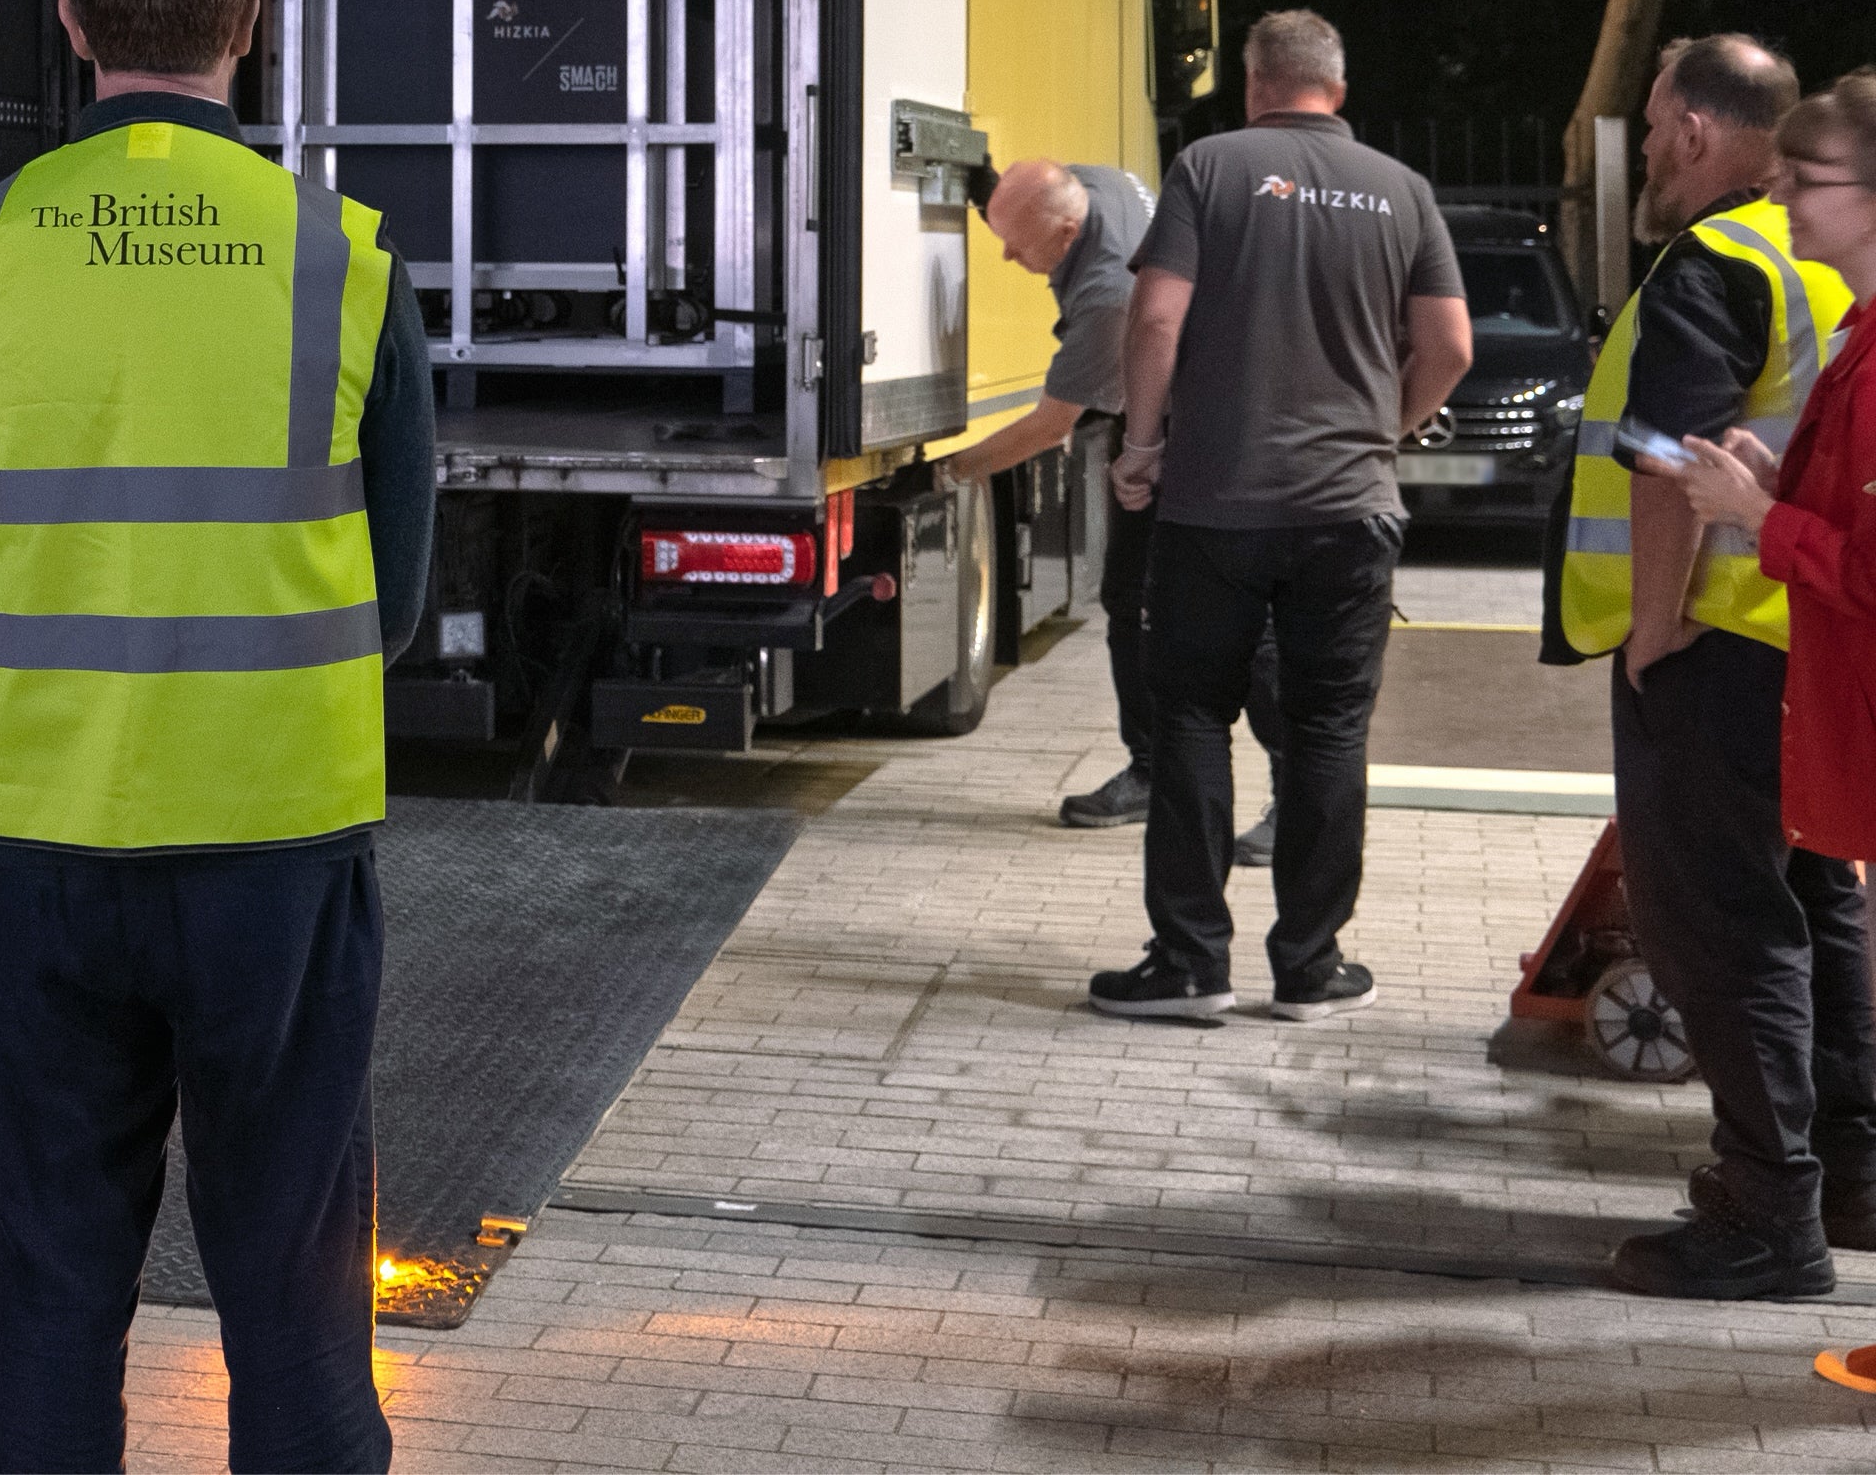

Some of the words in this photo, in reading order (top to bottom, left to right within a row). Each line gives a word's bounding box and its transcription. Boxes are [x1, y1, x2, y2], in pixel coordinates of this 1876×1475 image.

[494, 25, 550, 39] HIZKIA
[559, 65, 618, 92] SMACH
[30, 206, 84, 228] The
[87, 192, 221, 227] British
[1299, 186, 1393, 216] HIZKIA
[85, 230, 266, 267] Museum
